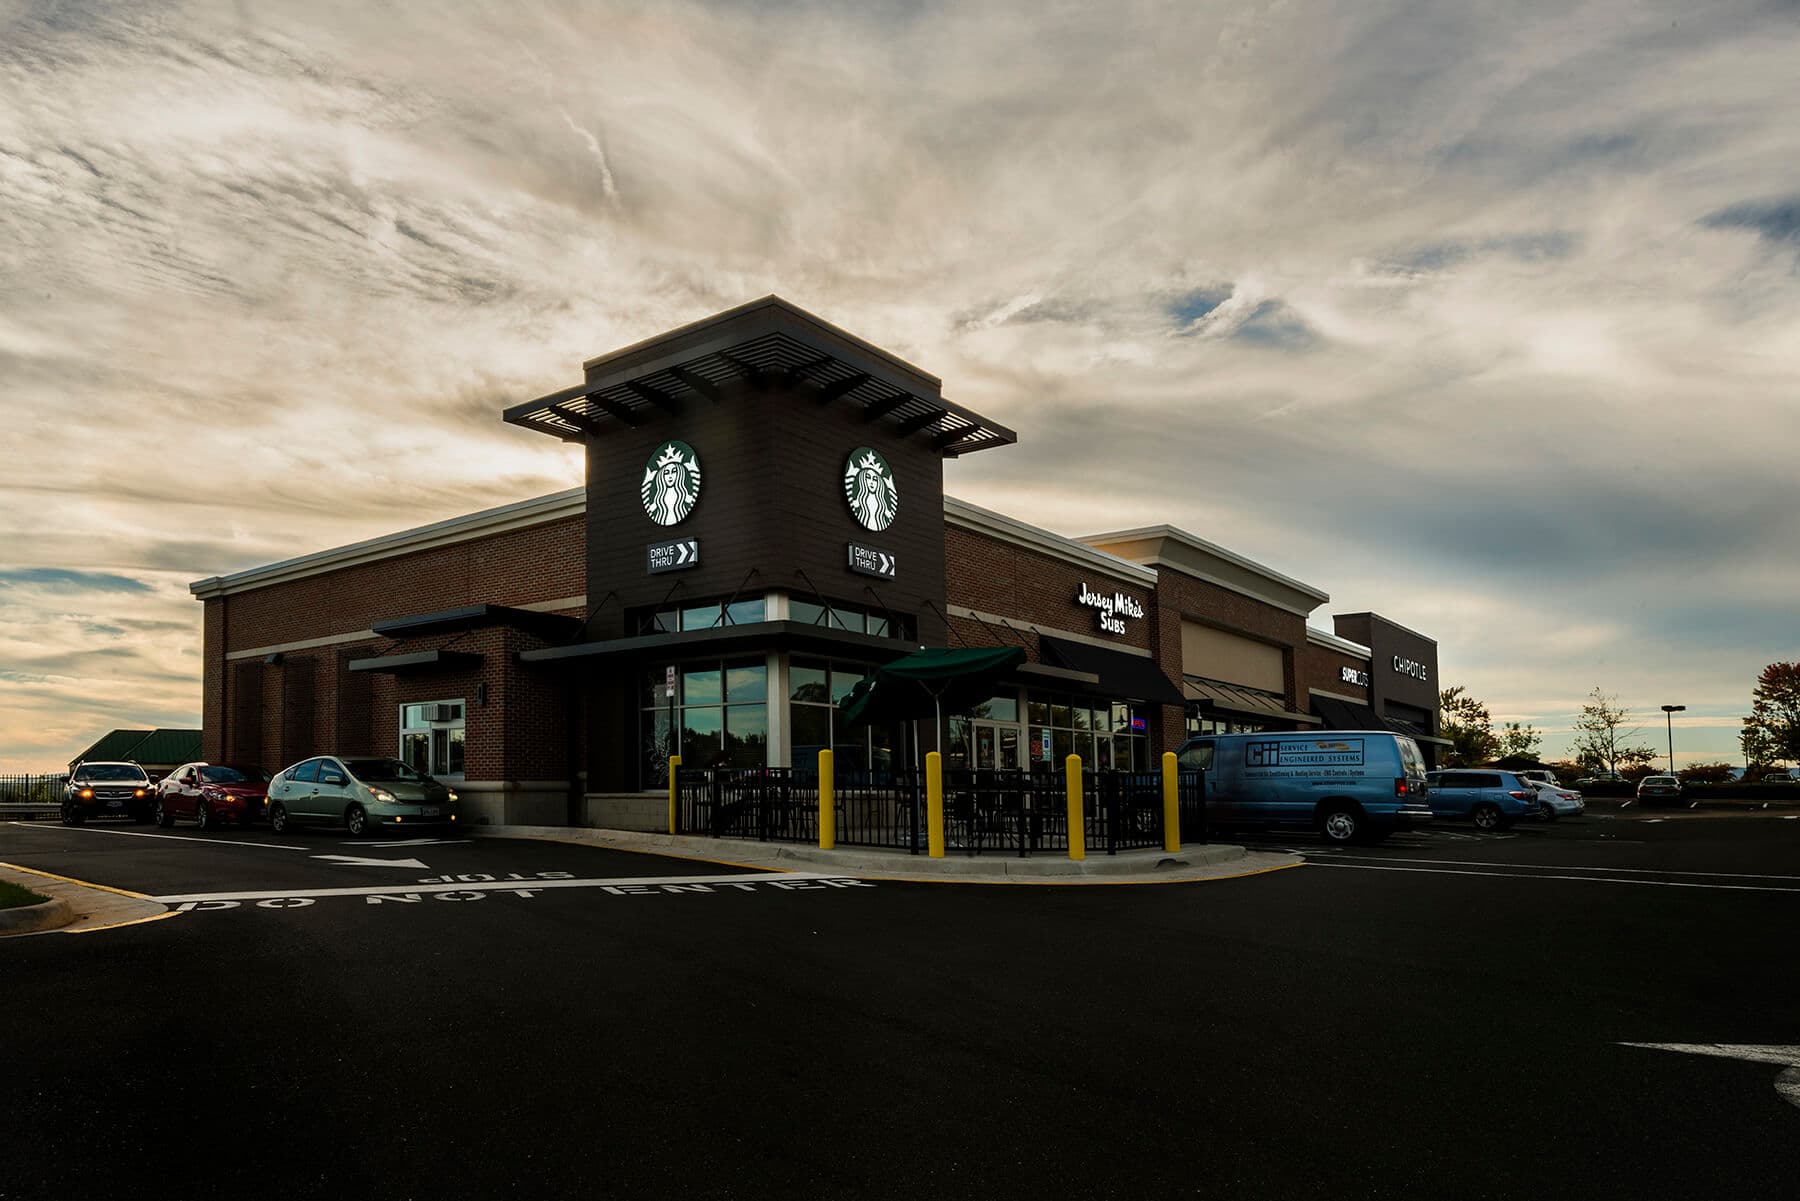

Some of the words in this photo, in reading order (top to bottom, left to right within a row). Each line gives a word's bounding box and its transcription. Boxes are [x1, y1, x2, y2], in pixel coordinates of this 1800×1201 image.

[650, 545, 674, 558] DRIVE
[855, 546, 877, 561] DRIVE
[650, 556, 673, 568] THRU
[855, 557, 876, 570] THRU
[1079, 582, 1114, 617] Jersey
[1114, 592, 1144, 619] Mike's
[1393, 655, 1427, 681] CHIPOTLE
[1280, 744, 1308, 752] SERVICE
[1280, 755, 1325, 763] ENGINEERED
[1329, 754, 1360, 762] SYSTEMS
[417, 871, 575, 883] STOP
[176, 898, 316, 911] DO
[366, 888, 543, 904] NOT
[600, 878, 878, 895] ENTER
